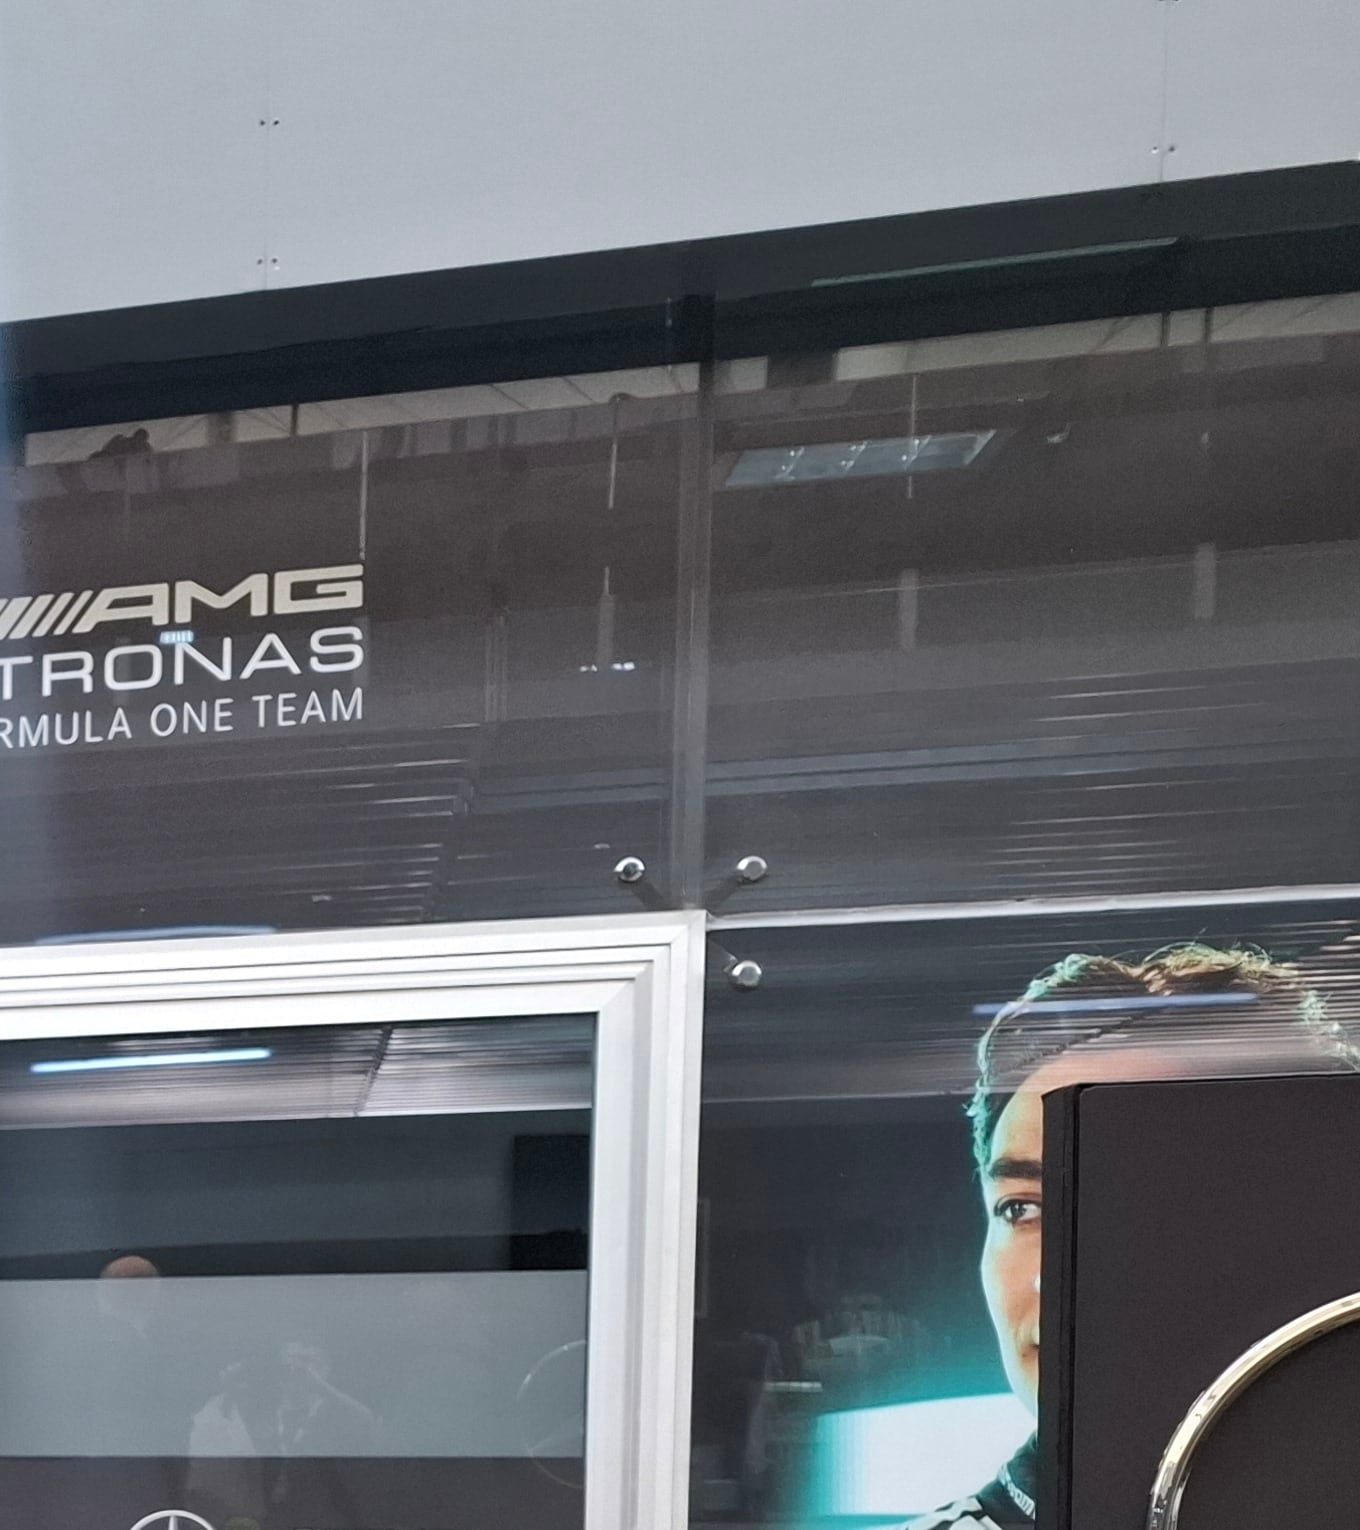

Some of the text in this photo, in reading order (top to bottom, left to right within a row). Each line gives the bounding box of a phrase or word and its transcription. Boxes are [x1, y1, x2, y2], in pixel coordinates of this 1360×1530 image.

[71, 564, 364, 633] AMG
[150, 699, 234, 738] ONE
[252, 687, 364, 729] TEAM
